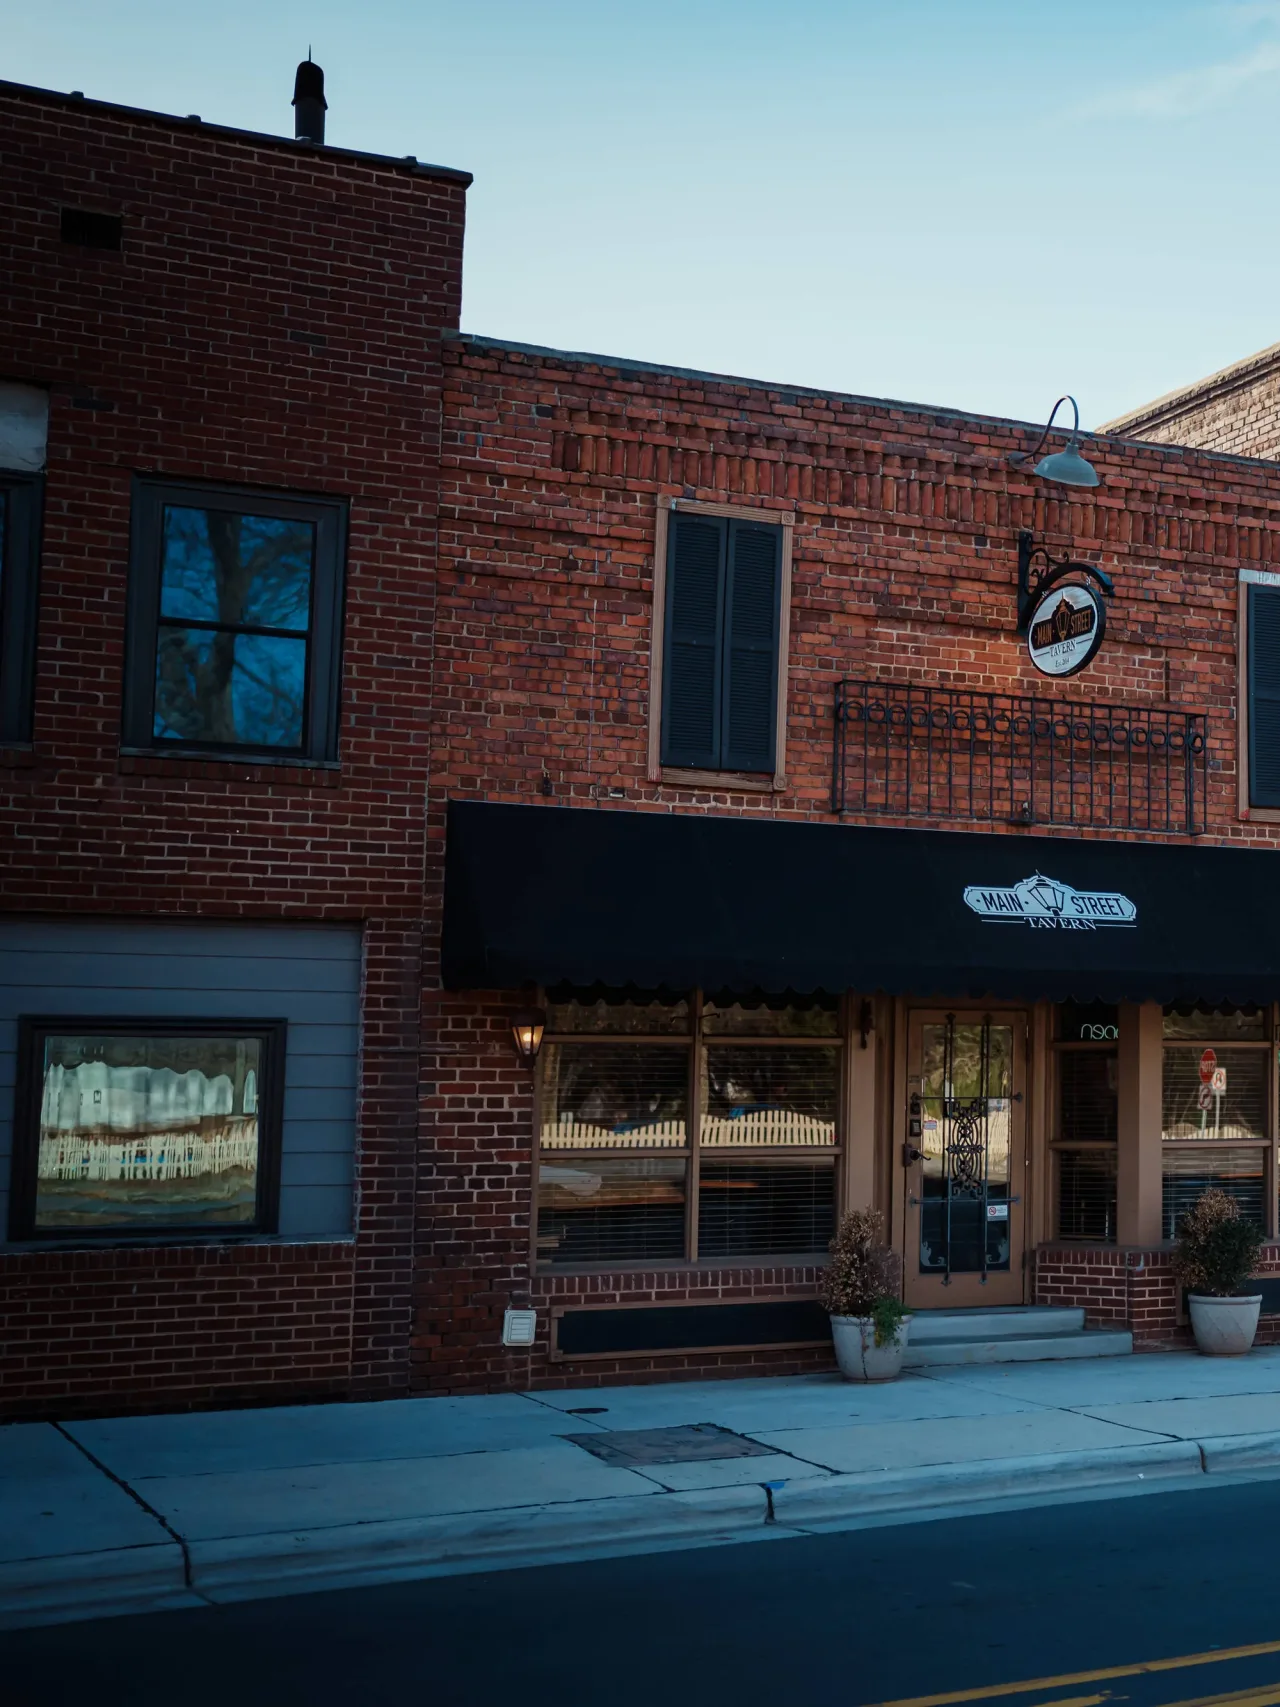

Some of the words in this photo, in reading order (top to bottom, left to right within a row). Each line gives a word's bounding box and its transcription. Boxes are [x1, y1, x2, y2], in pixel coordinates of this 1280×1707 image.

[1037, 623, 1053, 646] MAIN
[1070, 610, 1092, 634] STREET
[1050, 639, 1077, 657] TAVERN
[981, 891, 1025, 912] MAIN
[1070, 896, 1126, 916] STREET
[1023, 917, 1097, 930] TAVERN
